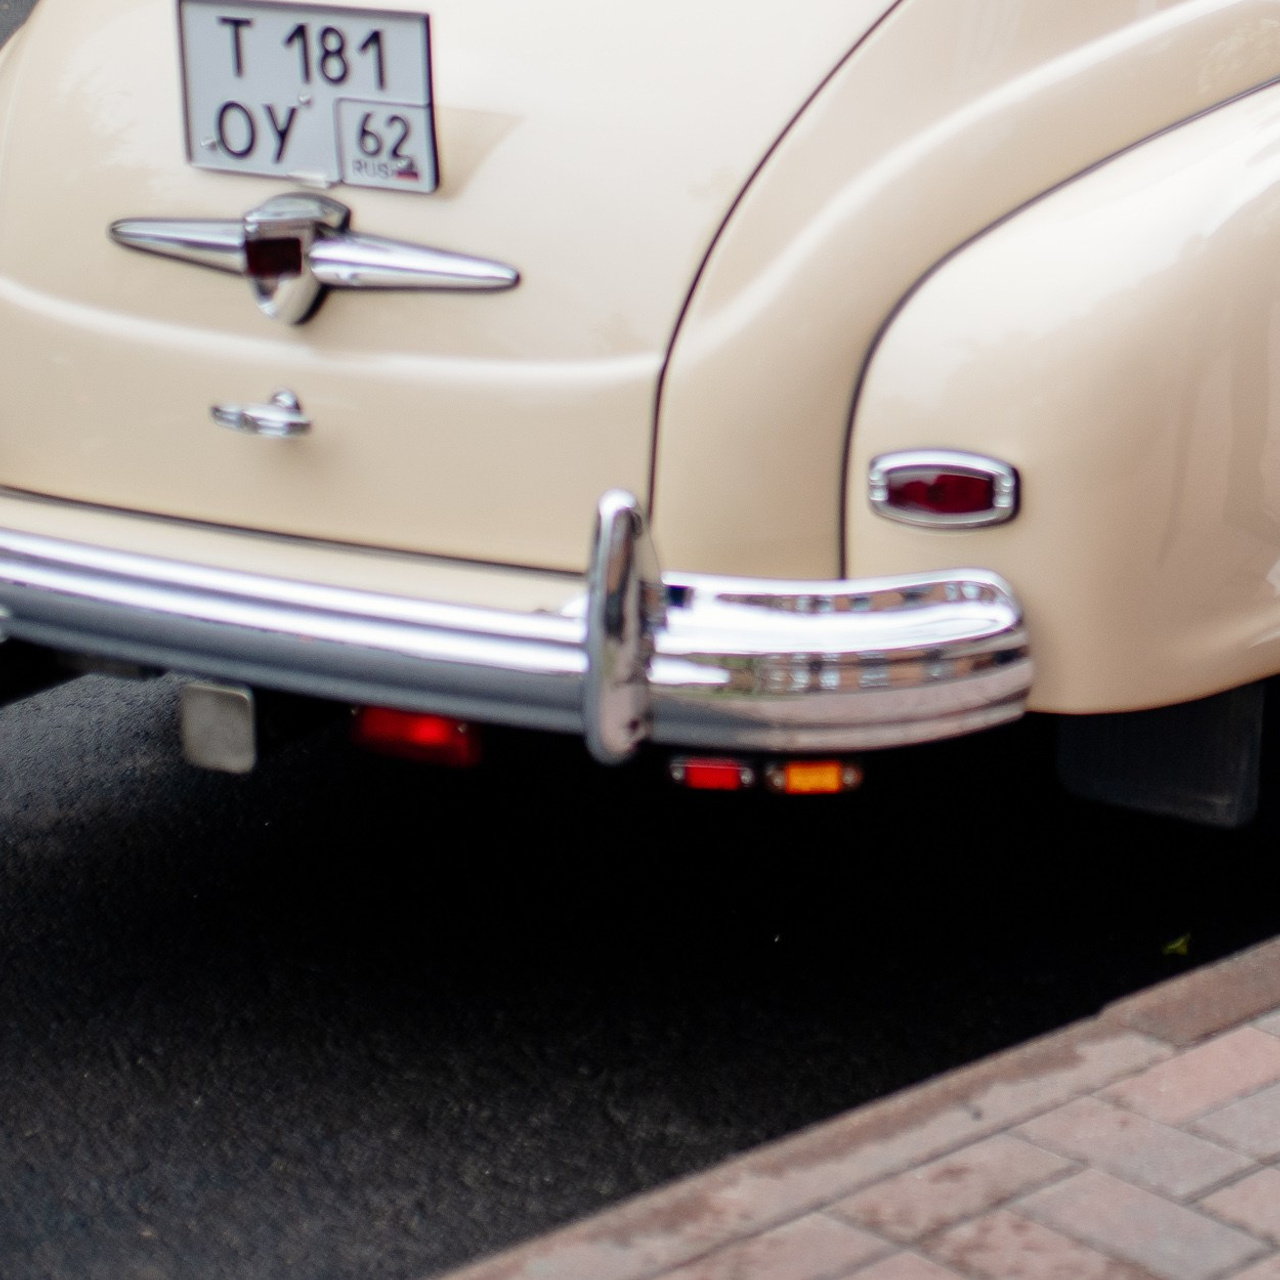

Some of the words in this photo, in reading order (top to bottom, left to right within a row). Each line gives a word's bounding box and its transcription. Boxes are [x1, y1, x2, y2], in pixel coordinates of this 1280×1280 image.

[284, 23, 386, 90] 181
[358, 112, 412, 159] 62
[352, 160, 391, 180] RUS
